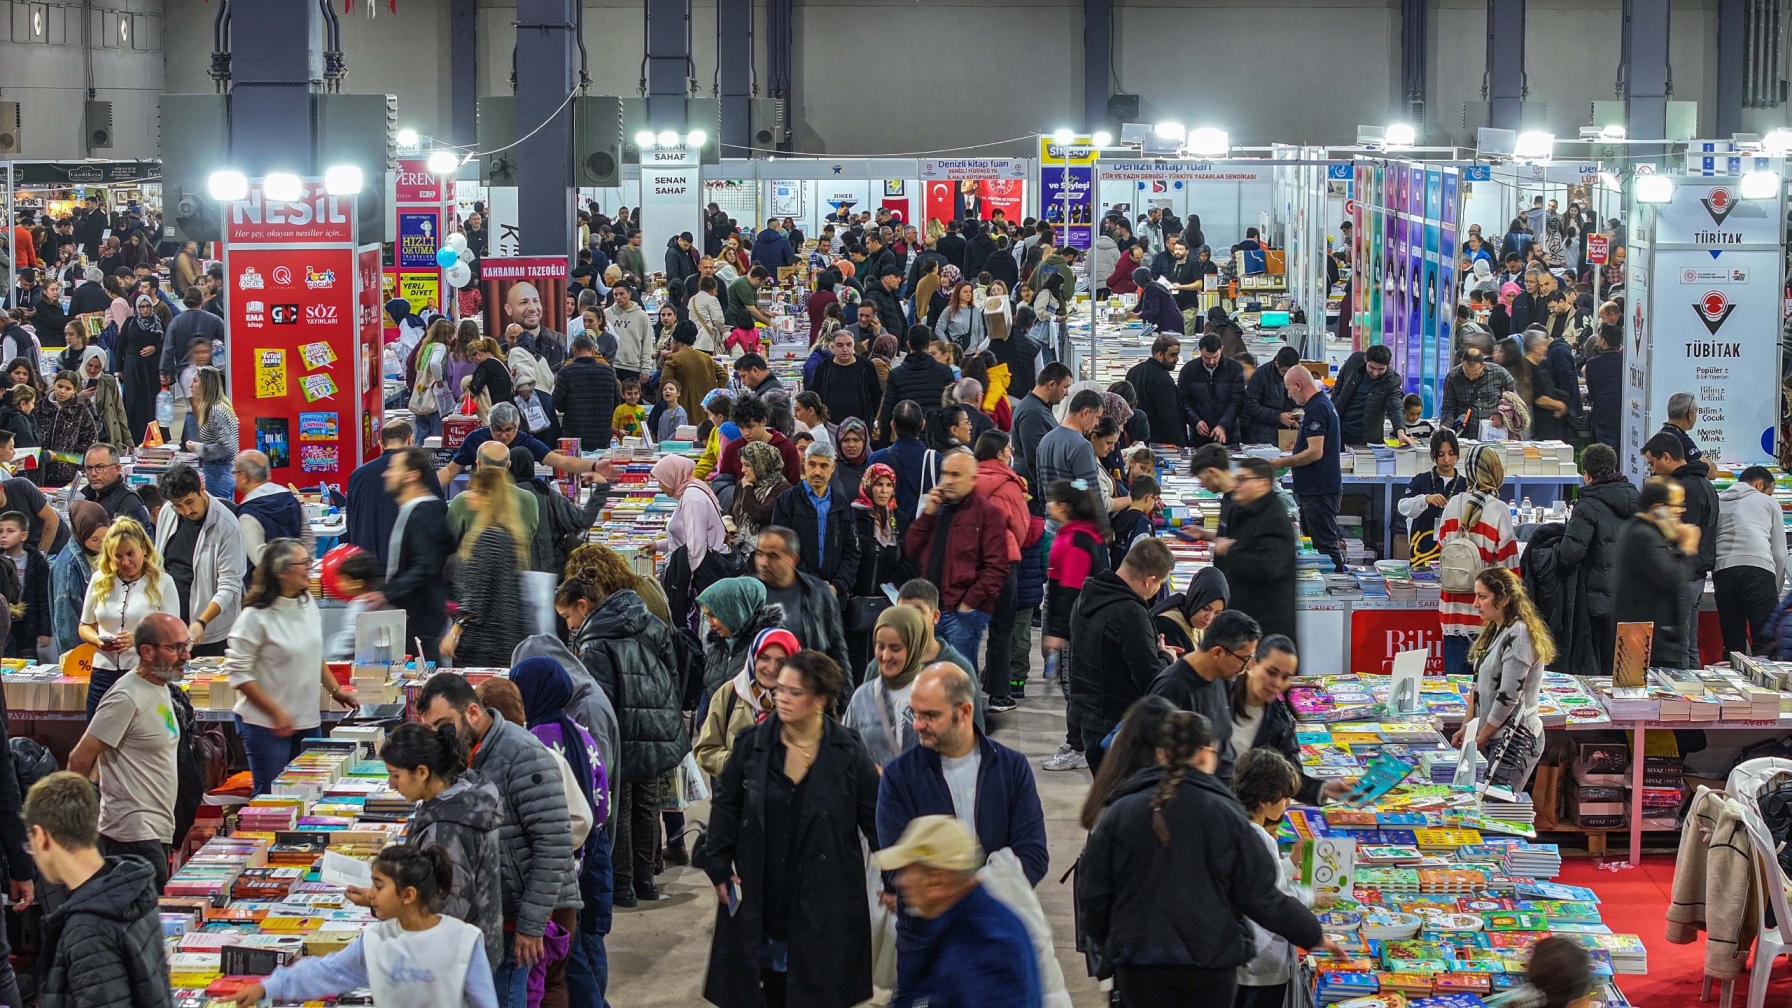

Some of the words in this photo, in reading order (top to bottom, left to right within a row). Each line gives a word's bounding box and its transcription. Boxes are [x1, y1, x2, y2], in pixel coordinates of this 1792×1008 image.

[938, 160, 966, 168] Denizli
[968, 160, 988, 169] kitap
[988, 160, 1009, 168] fuarı
[1154, 164, 1183, 173] kitap
[1581, 174, 1598, 183] LÜT
[1060, 182, 1090, 190] Syleşi
[233, 188, 346, 226] NESİL
[234, 230, 250, 238] Her
[266, 230, 294, 238] okuyan
[296, 229, 323, 238] nesiller
[1694, 230, 1742, 244] TÜBİTAK
[402, 236, 435, 246] HIZLI
[402, 246, 435, 254] OKUMA
[483, 266, 525, 278] KAHRAMAN
[528, 264, 566, 276] TAZEOĞLU
[308, 280, 333, 290] çocuk
[404, 282, 424, 290] YERLİ
[306, 304, 338, 318] SÖZ
[1685, 340, 1741, 358] TÜBİTAK
[1696, 366, 1723, 374] Popüler
[1700, 386, 1721, 394] Bilim
[1702, 414, 1724, 422] Çocuk
[1697, 428, 1723, 436] Meraklı
[265, 434, 274, 444] ON
[10, 712, 44, 720] SARAY
